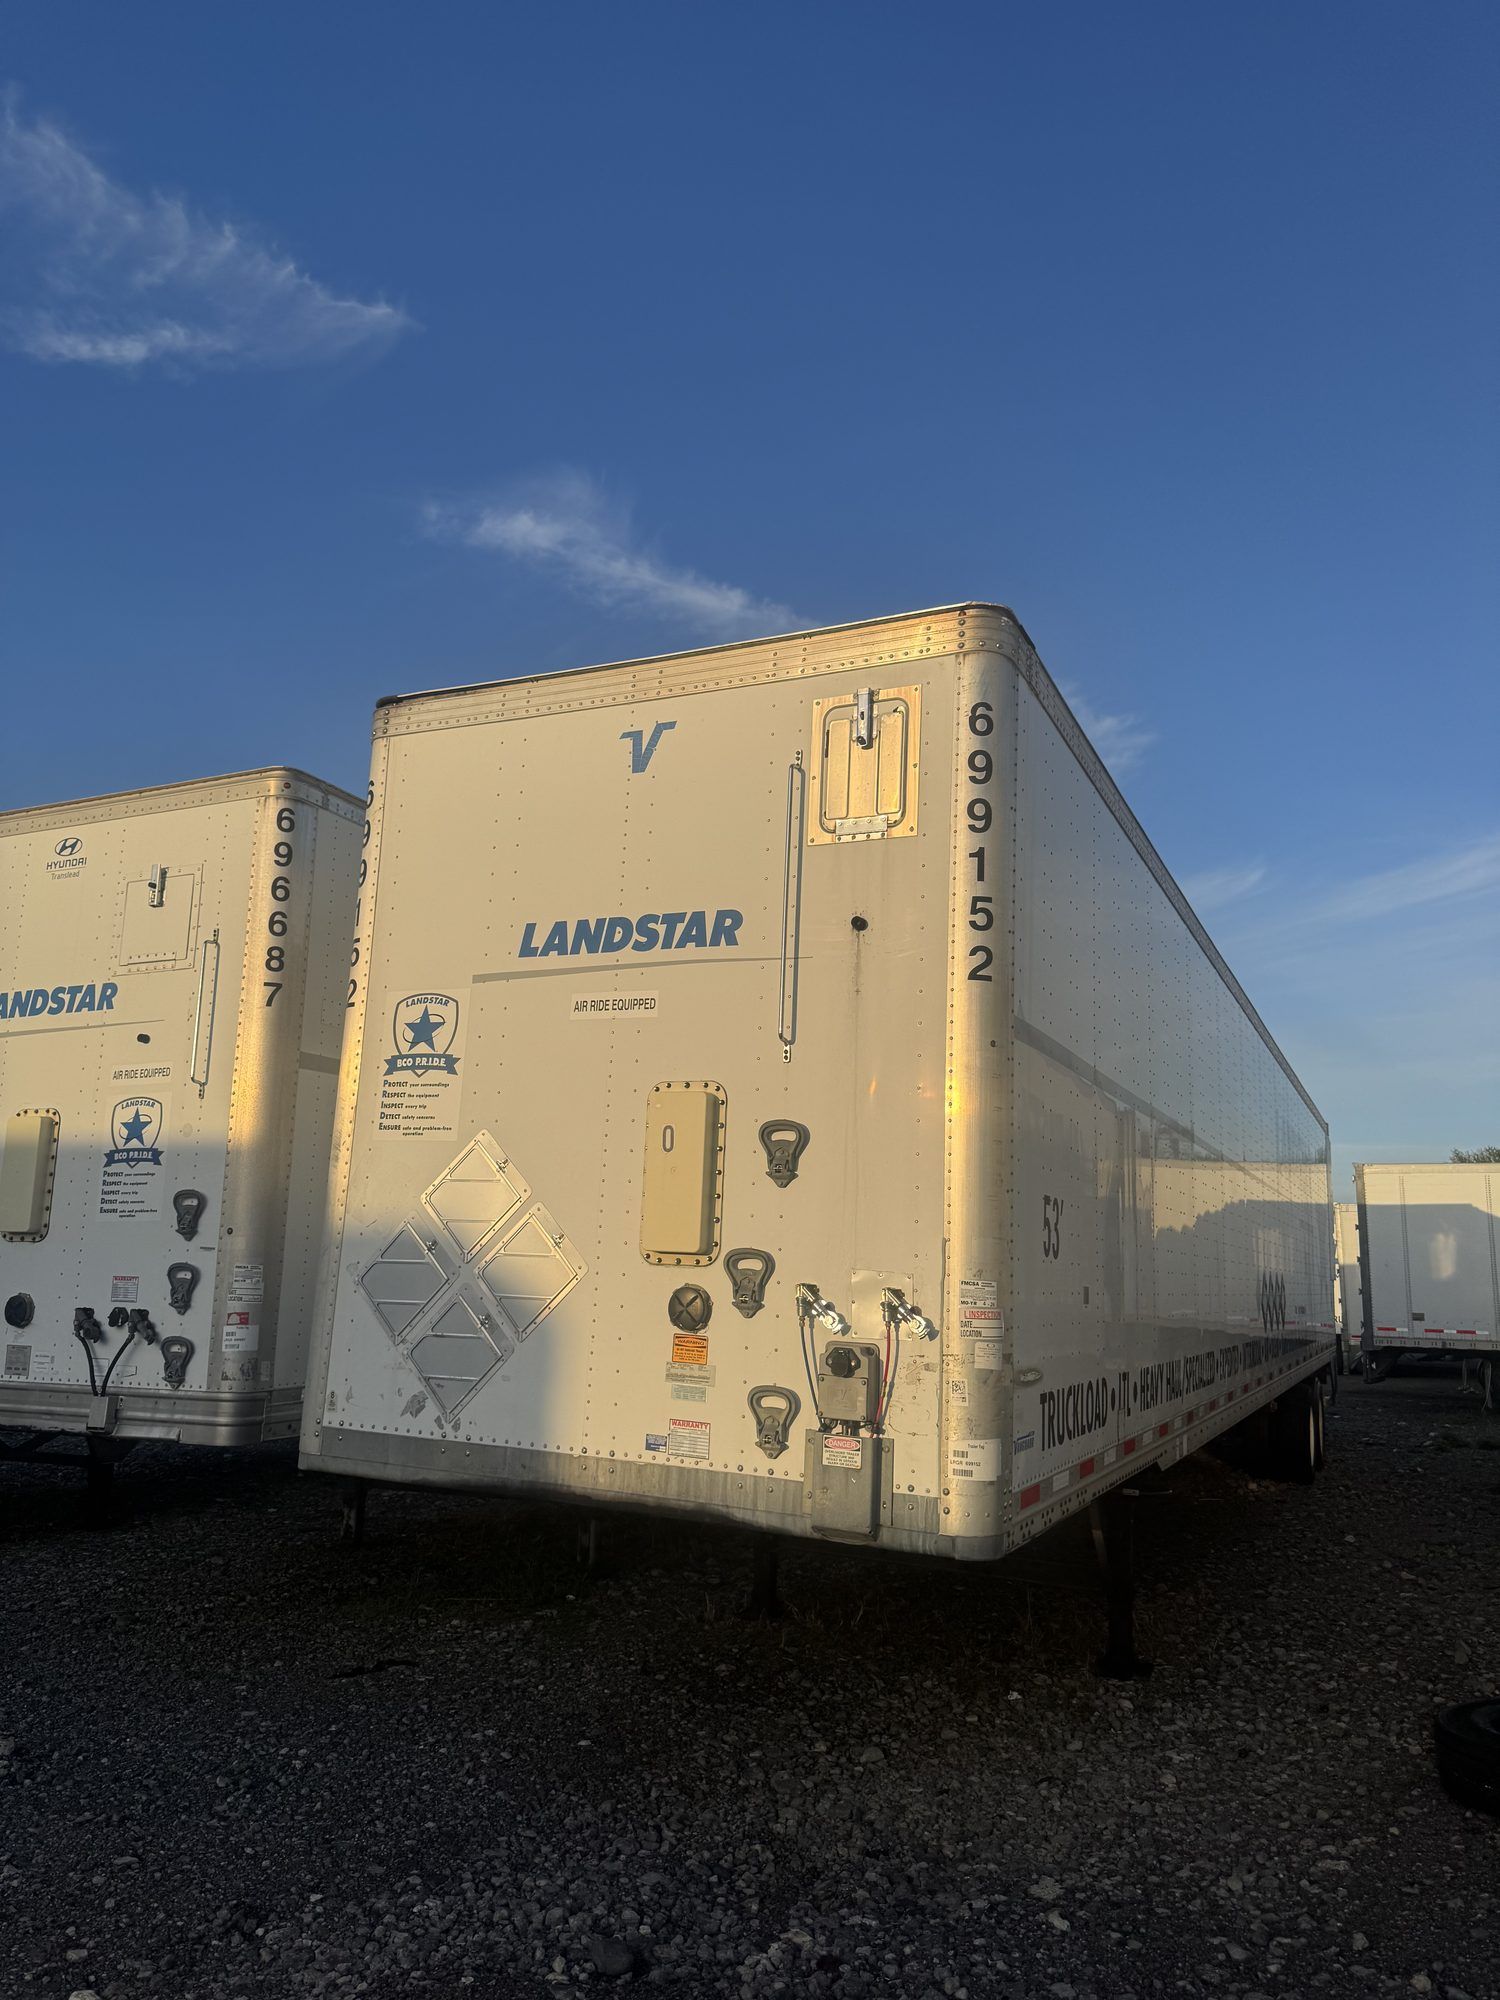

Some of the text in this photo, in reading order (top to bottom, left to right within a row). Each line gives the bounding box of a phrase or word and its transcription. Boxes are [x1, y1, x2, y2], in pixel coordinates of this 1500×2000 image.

[967, 701, 994, 983] 699152
[46, 857, 88, 870] HYUNDAI
[51, 871, 80, 880] Translead
[262, 807, 297, 1008] 696687
[518, 909, 744, 958] LANDSTAR
[0, 982, 119, 1019] ANDSTAR
[405, 996, 450, 1008] LANDSTAR
[573, 998, 656, 1013] AIR RIDE EQUIPPED
[112, 1067, 171, 1080] AIR RIDE EQUIPPED
[383, 1079, 408, 1088] PROTECT
[382, 1090, 406, 1098] RESPECT
[121, 1099, 156, 1110] LANDSTAR
[380, 1101, 404, 1109] INSPECT
[380, 1112, 401, 1120] DETECT
[378, 1122, 401, 1130] ENSURE
[103, 1170, 123, 1178] PROTECT
[102, 1179, 122, 1187] RESPECT
[101, 1188, 120, 1196] INSPECT
[100, 1197, 118, 1205] DETECT
[99, 1206, 118, 1214] ENSURE
[960, 1320, 973, 1329] DATE
[960, 1329, 983, 1338] LOCATION
[1040, 1376, 1109, 1451] TRUCKLOAD
[1139, 1363, 1165, 1413] HEAVY
[671, 1419, 709, 1430] WARRANTY
[828, 1439, 856, 1448] DANGER
